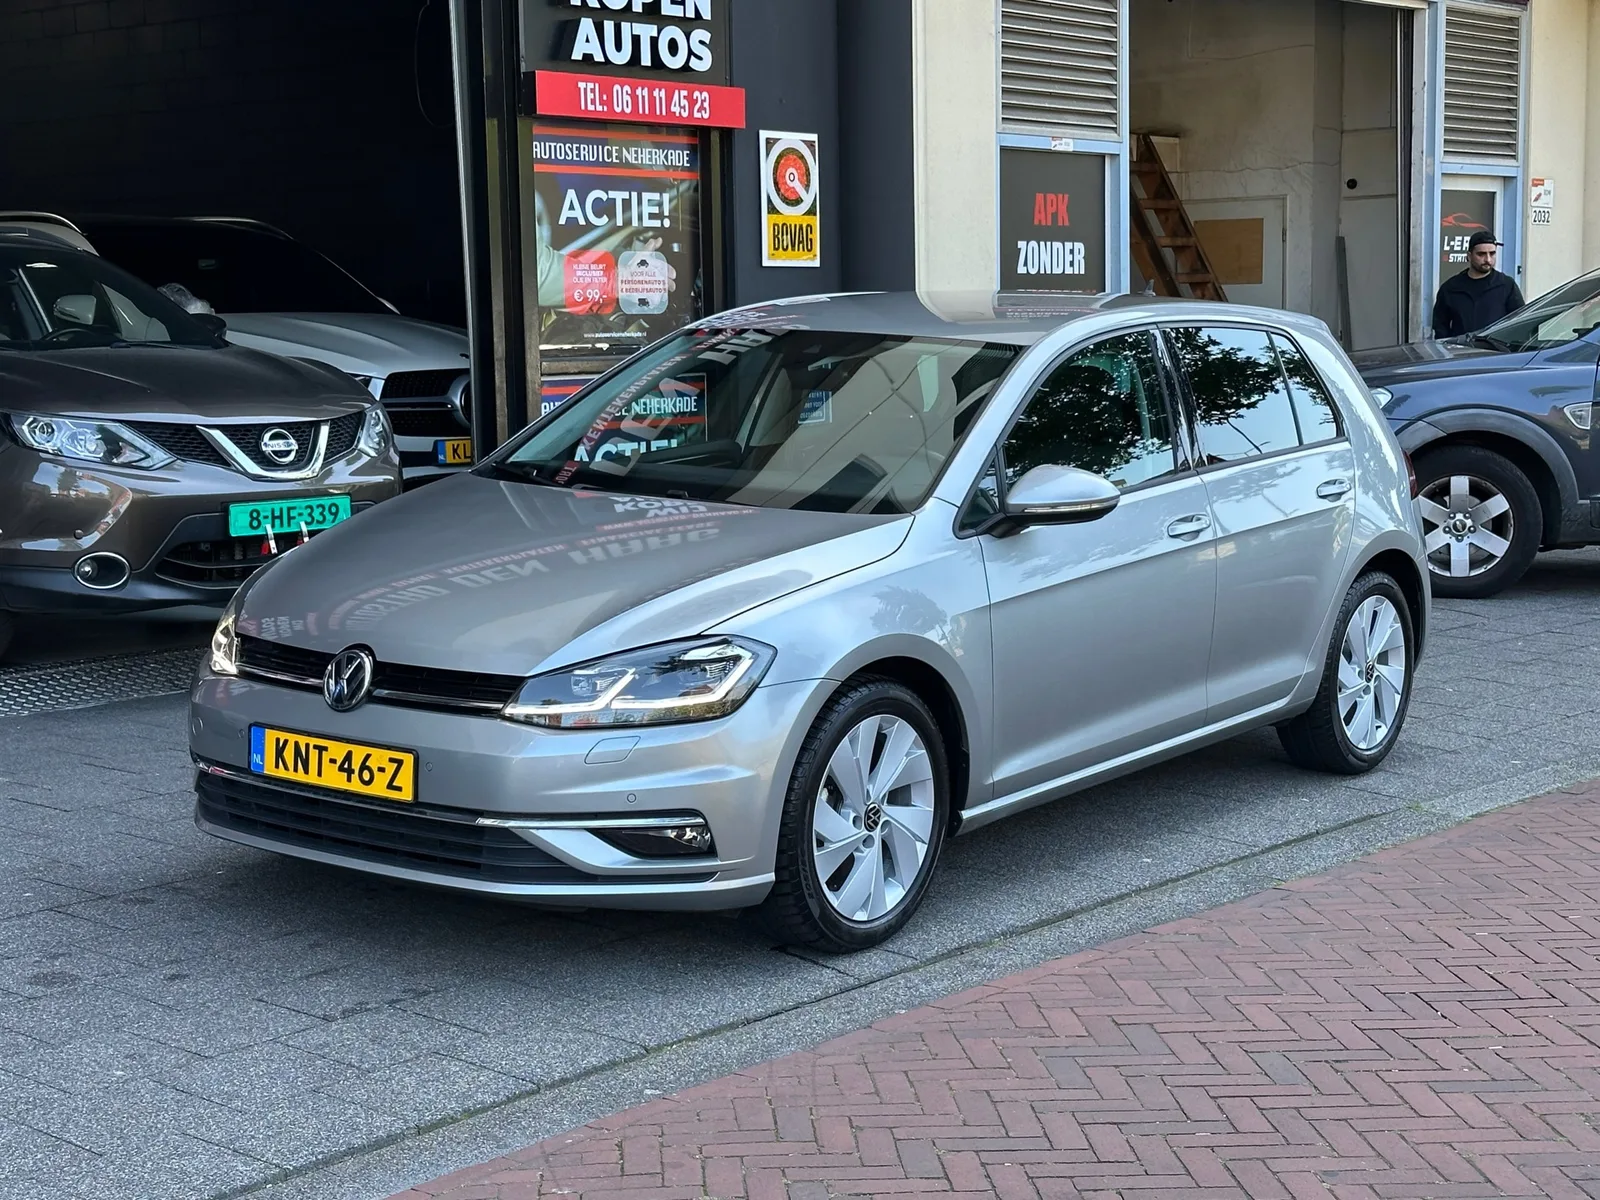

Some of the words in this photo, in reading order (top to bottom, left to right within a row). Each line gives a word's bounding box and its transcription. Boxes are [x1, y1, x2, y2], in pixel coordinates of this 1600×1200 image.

[571, 17, 712, 72] AUTOS
[578, 82, 607, 112] TEL:
[613, 85, 632, 114] 06
[636, 87, 649, 115] 11
[653, 88, 666, 116] 11
[670, 90, 689, 118] 45
[693, 91, 710, 119] 23
[533, 141, 619, 163] AUTOSERVICE
[622, 147, 690, 167] NEHERKADE
[558, 188, 671, 228] ACTIE!
[1034, 193, 1070, 226] APK
[1533, 210, 1550, 223] 2032
[772, 223, 813, 252] BOVAG
[1017, 240, 1085, 275] ZONDER
[574, 289, 584, 302] €
[586, 289, 607, 304] 99,-
[632, 396, 698, 415] NEHERKADE
[249, 503, 340, 530] 8-HF-339
[253, 753, 264, 765] NL
[274, 736, 404, 792] KNT-46-Z
